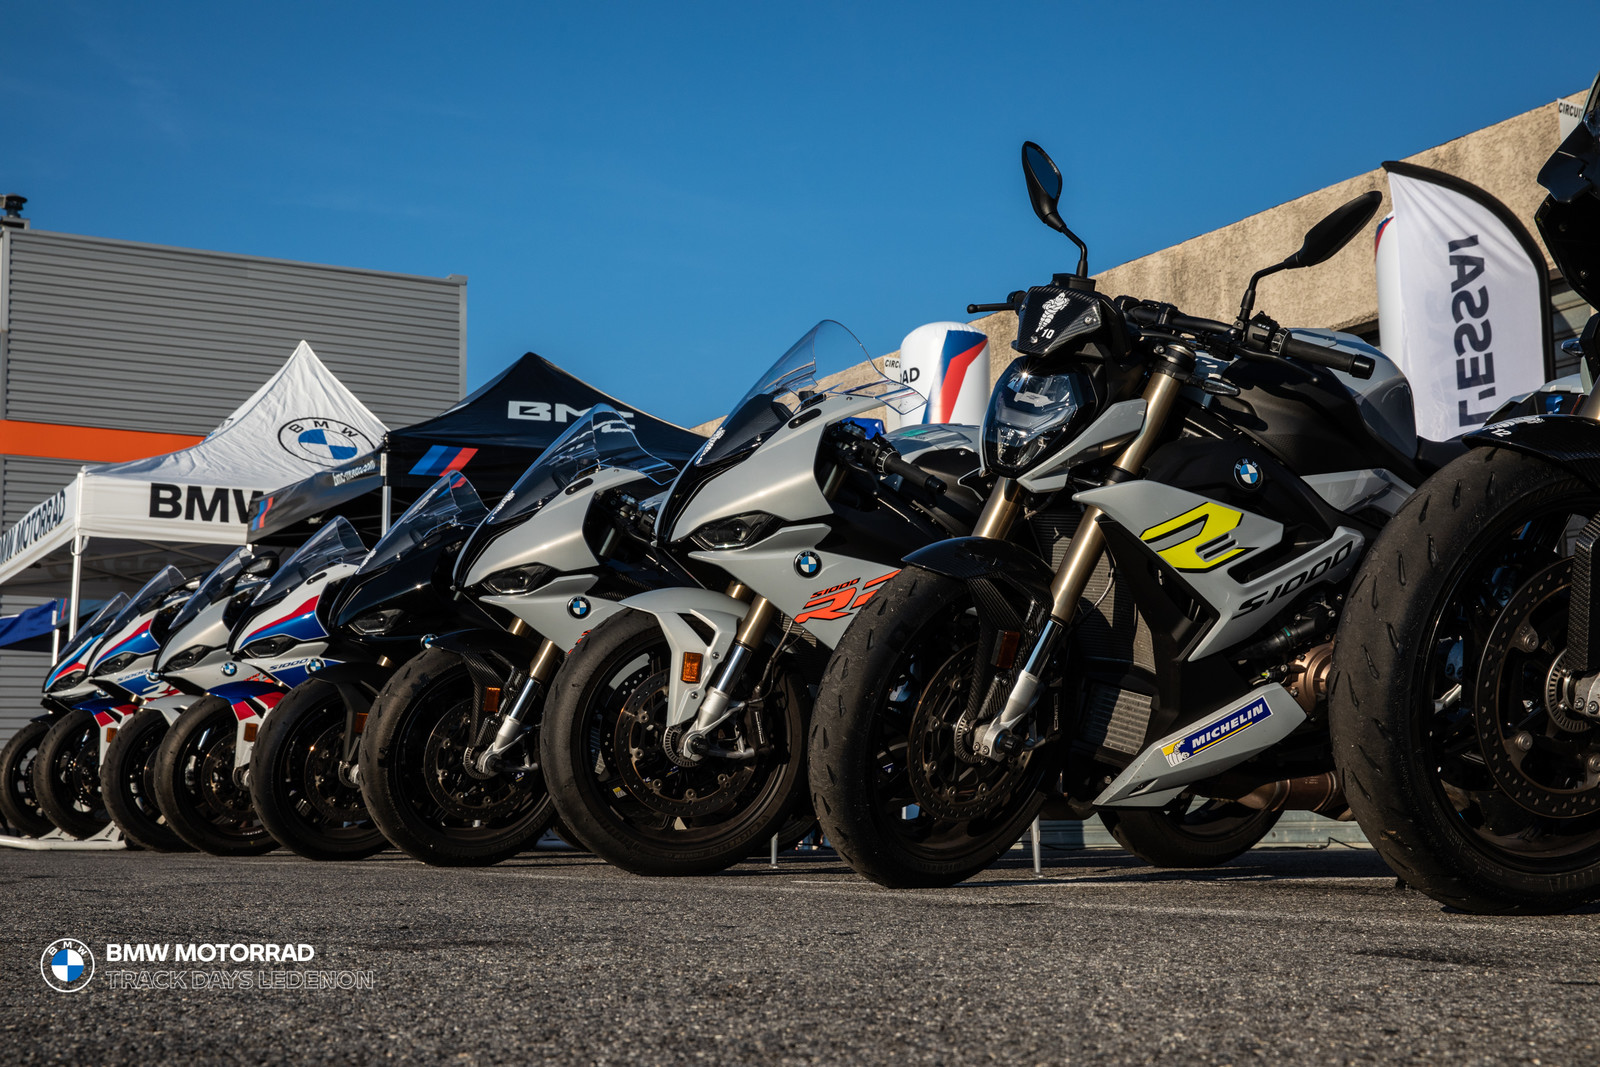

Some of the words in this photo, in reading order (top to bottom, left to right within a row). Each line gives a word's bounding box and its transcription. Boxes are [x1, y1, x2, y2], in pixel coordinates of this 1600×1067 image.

[1041, 328, 1055, 339] 10
[900, 366, 920, 385] AD
[288, 420, 359, 438] BMW
[1490, 428, 1512, 438] 12
[15, 488, 66, 556] MOTORRAD
[810, 577, 861, 599] S1000
[1230, 540, 1355, 620] S1000
[269, 658, 309, 670] S1000
[1191, 703, 1264, 749] MICHELIN
